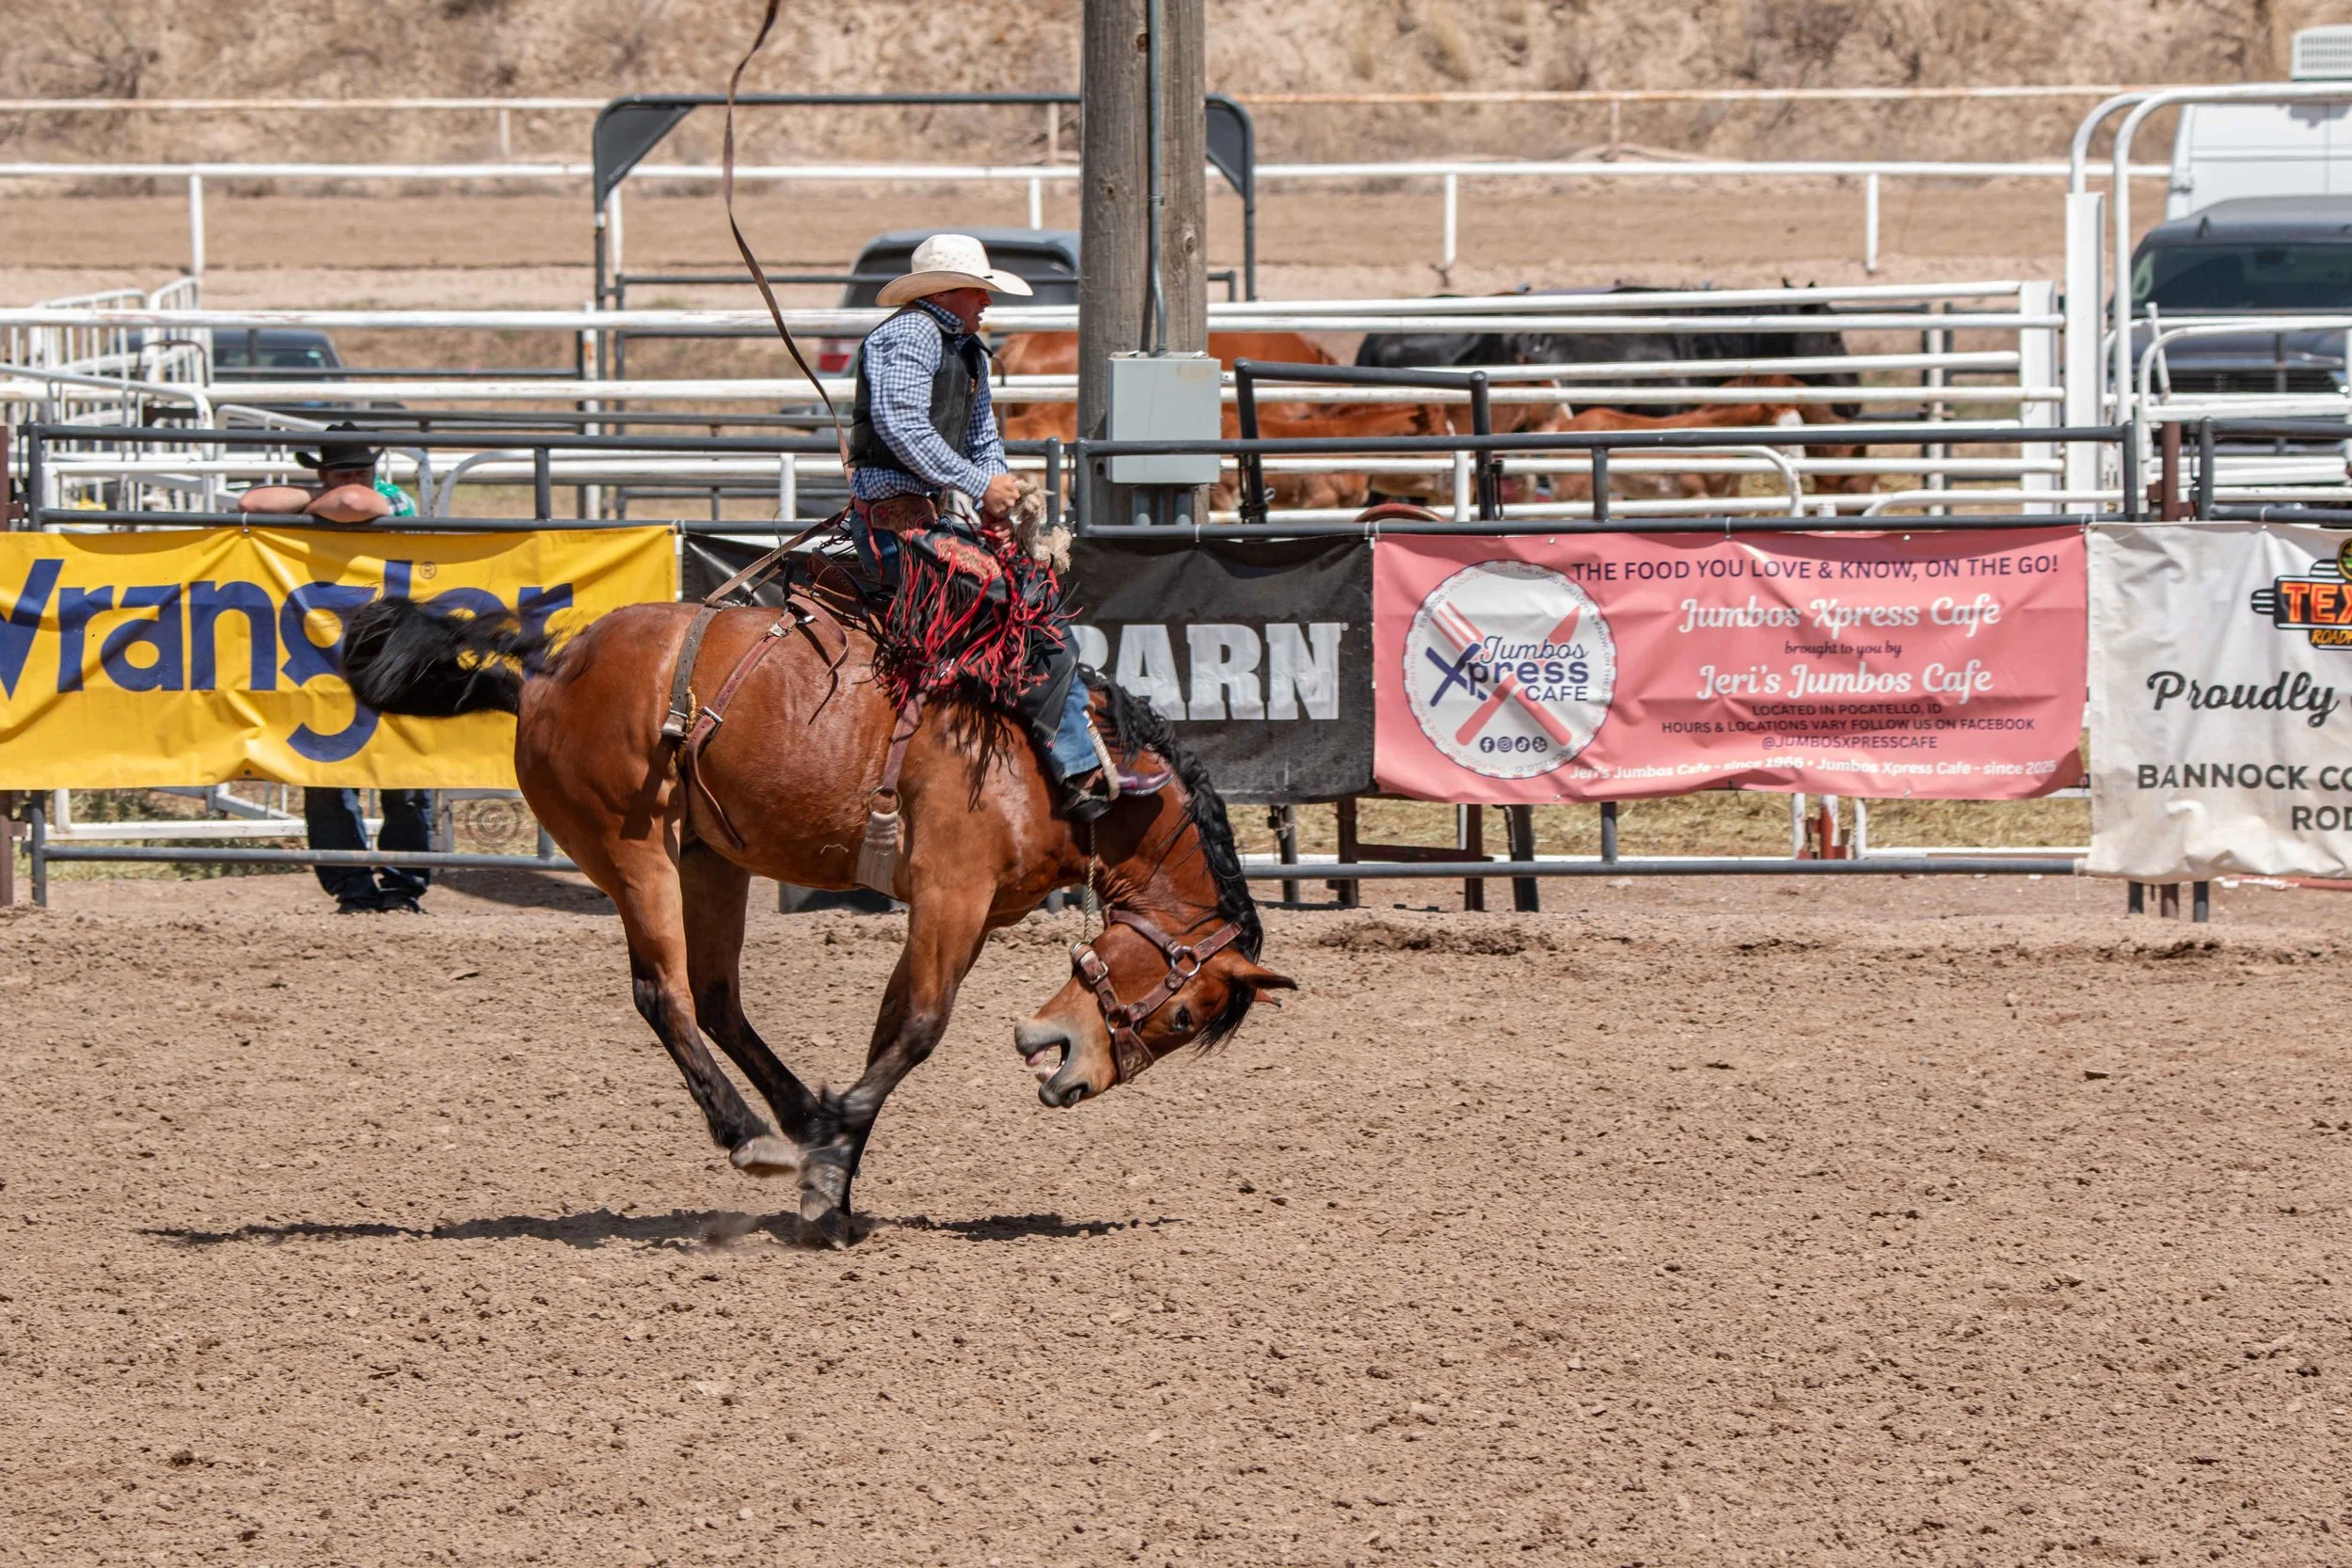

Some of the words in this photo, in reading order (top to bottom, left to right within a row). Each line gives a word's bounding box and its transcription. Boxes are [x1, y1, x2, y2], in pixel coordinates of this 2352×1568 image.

[1571, 562, 1616, 580] THE
[1626, 562, 1690, 580] FOOD
[1696, 560, 1743, 578] YOU
[1752, 561, 1811, 578] LOVE
[1818, 562, 1833, 578] &
[1840, 562, 1917, 582] KNOW,
[1926, 560, 1959, 577] ON
[1967, 558, 2011, 576] THE
[2018, 555, 2058, 573] GO!
[1678, 594, 1802, 633] Jumbos
[1809, 597, 1919, 640] Xpress
[1931, 594, 2002, 638] Cafe
[1480, 635, 1589, 664] Jumbos
[1785, 641, 1837, 659] brought
[1840, 644, 1853, 655] to
[1856, 646, 1882, 659] you
[1885, 641, 1902, 657] by
[1425, 642, 1590, 707] Xpress
[1788, 660, 1912, 699] Jumbos
[1922, 659, 1994, 705] Cafe
[1525, 685, 1588, 702] CAFE
[2147, 672, 2340, 727] Proudly
[1752, 705, 1814, 716] LOCATED
[1820, 705, 1835, 715] IN
[1839, 704, 1925, 716] POCATELLO,
[1929, 704, 1942, 714] ID
[1662, 721, 1711, 733] HOURS
[1714, 721, 1724, 733] &
[1728, 720, 1808, 732] LOCATIONS
[1811, 720, 1847, 730] VARY
[1851, 720, 1910, 730] FOLLOW
[1914, 720, 1931, 730] US
[1934, 720, 1958, 730] ON
[1961, 719, 2035, 730] FACEBOOK
[1762, 736, 1938, 750] @JUMBOSXPRESSCAFE
[1613, 764, 1674, 779] Jumbos
[1677, 763, 1710, 775] Cafe
[1724, 759, 1762, 770] since
[1816, 758, 1880, 774] Jumbos
[1882, 761, 1933, 776] Xpress
[1936, 761, 1973, 775] Cafe
[1983, 762, 2023, 775] since
[2137, 763, 2310, 790] BANNOCK
